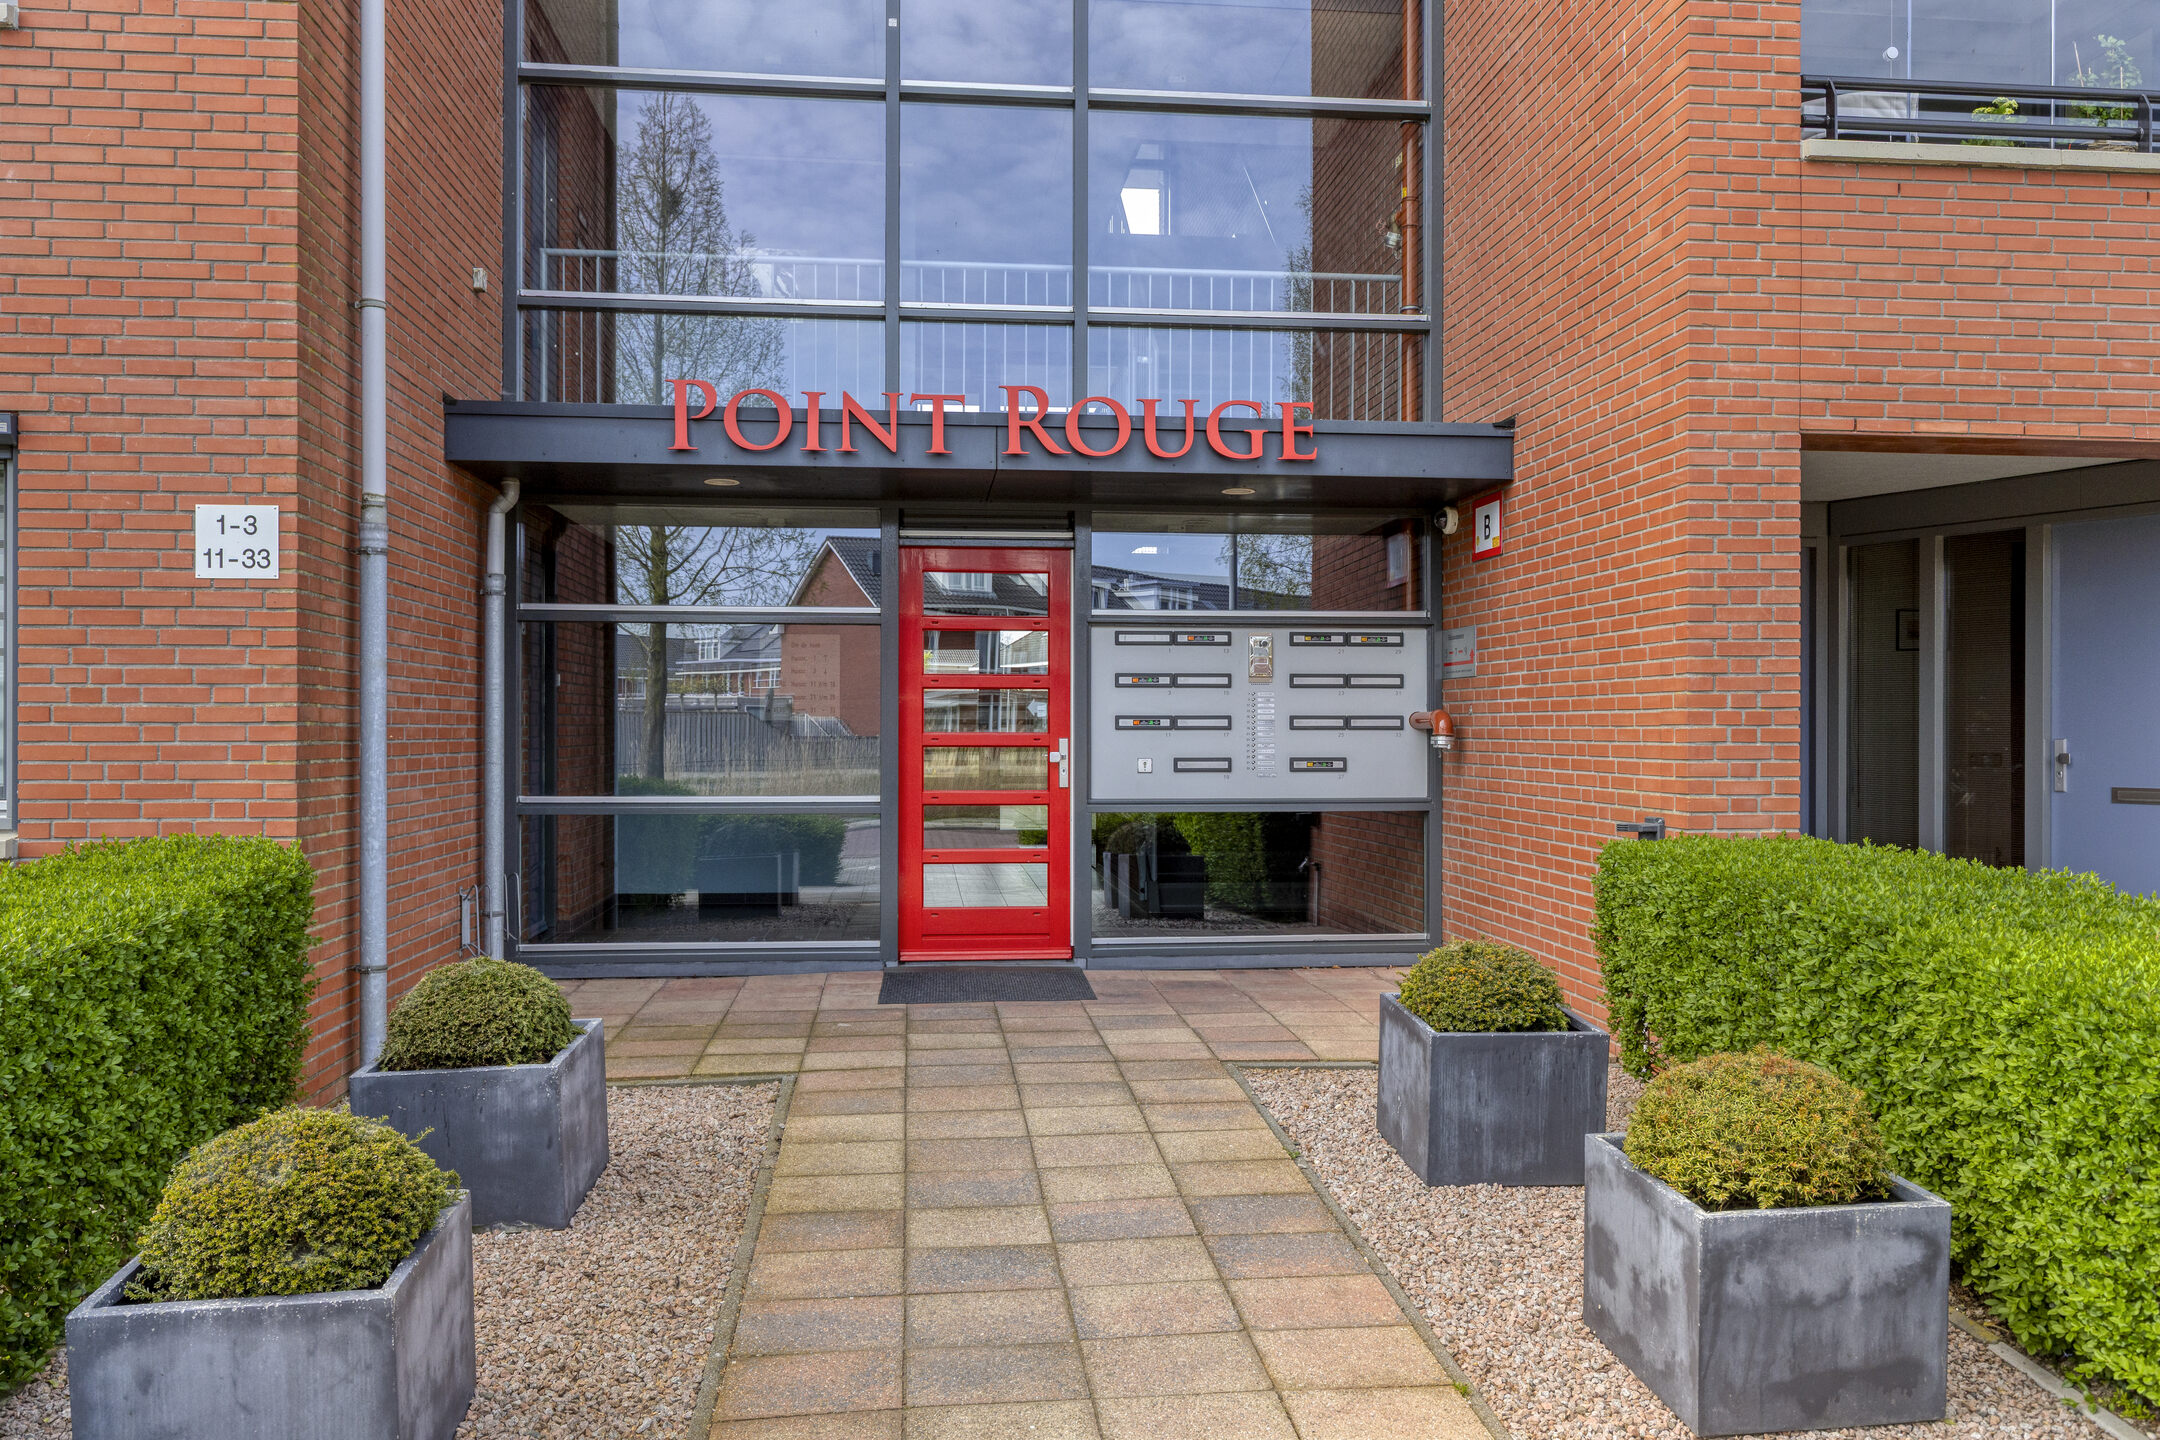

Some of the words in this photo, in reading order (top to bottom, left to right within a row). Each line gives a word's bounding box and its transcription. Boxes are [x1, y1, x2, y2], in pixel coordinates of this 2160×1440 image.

[216, 514, 258, 535] 1-3
[1484, 513, 1491, 541] B
[203, 548, 271, 569] 11-33
